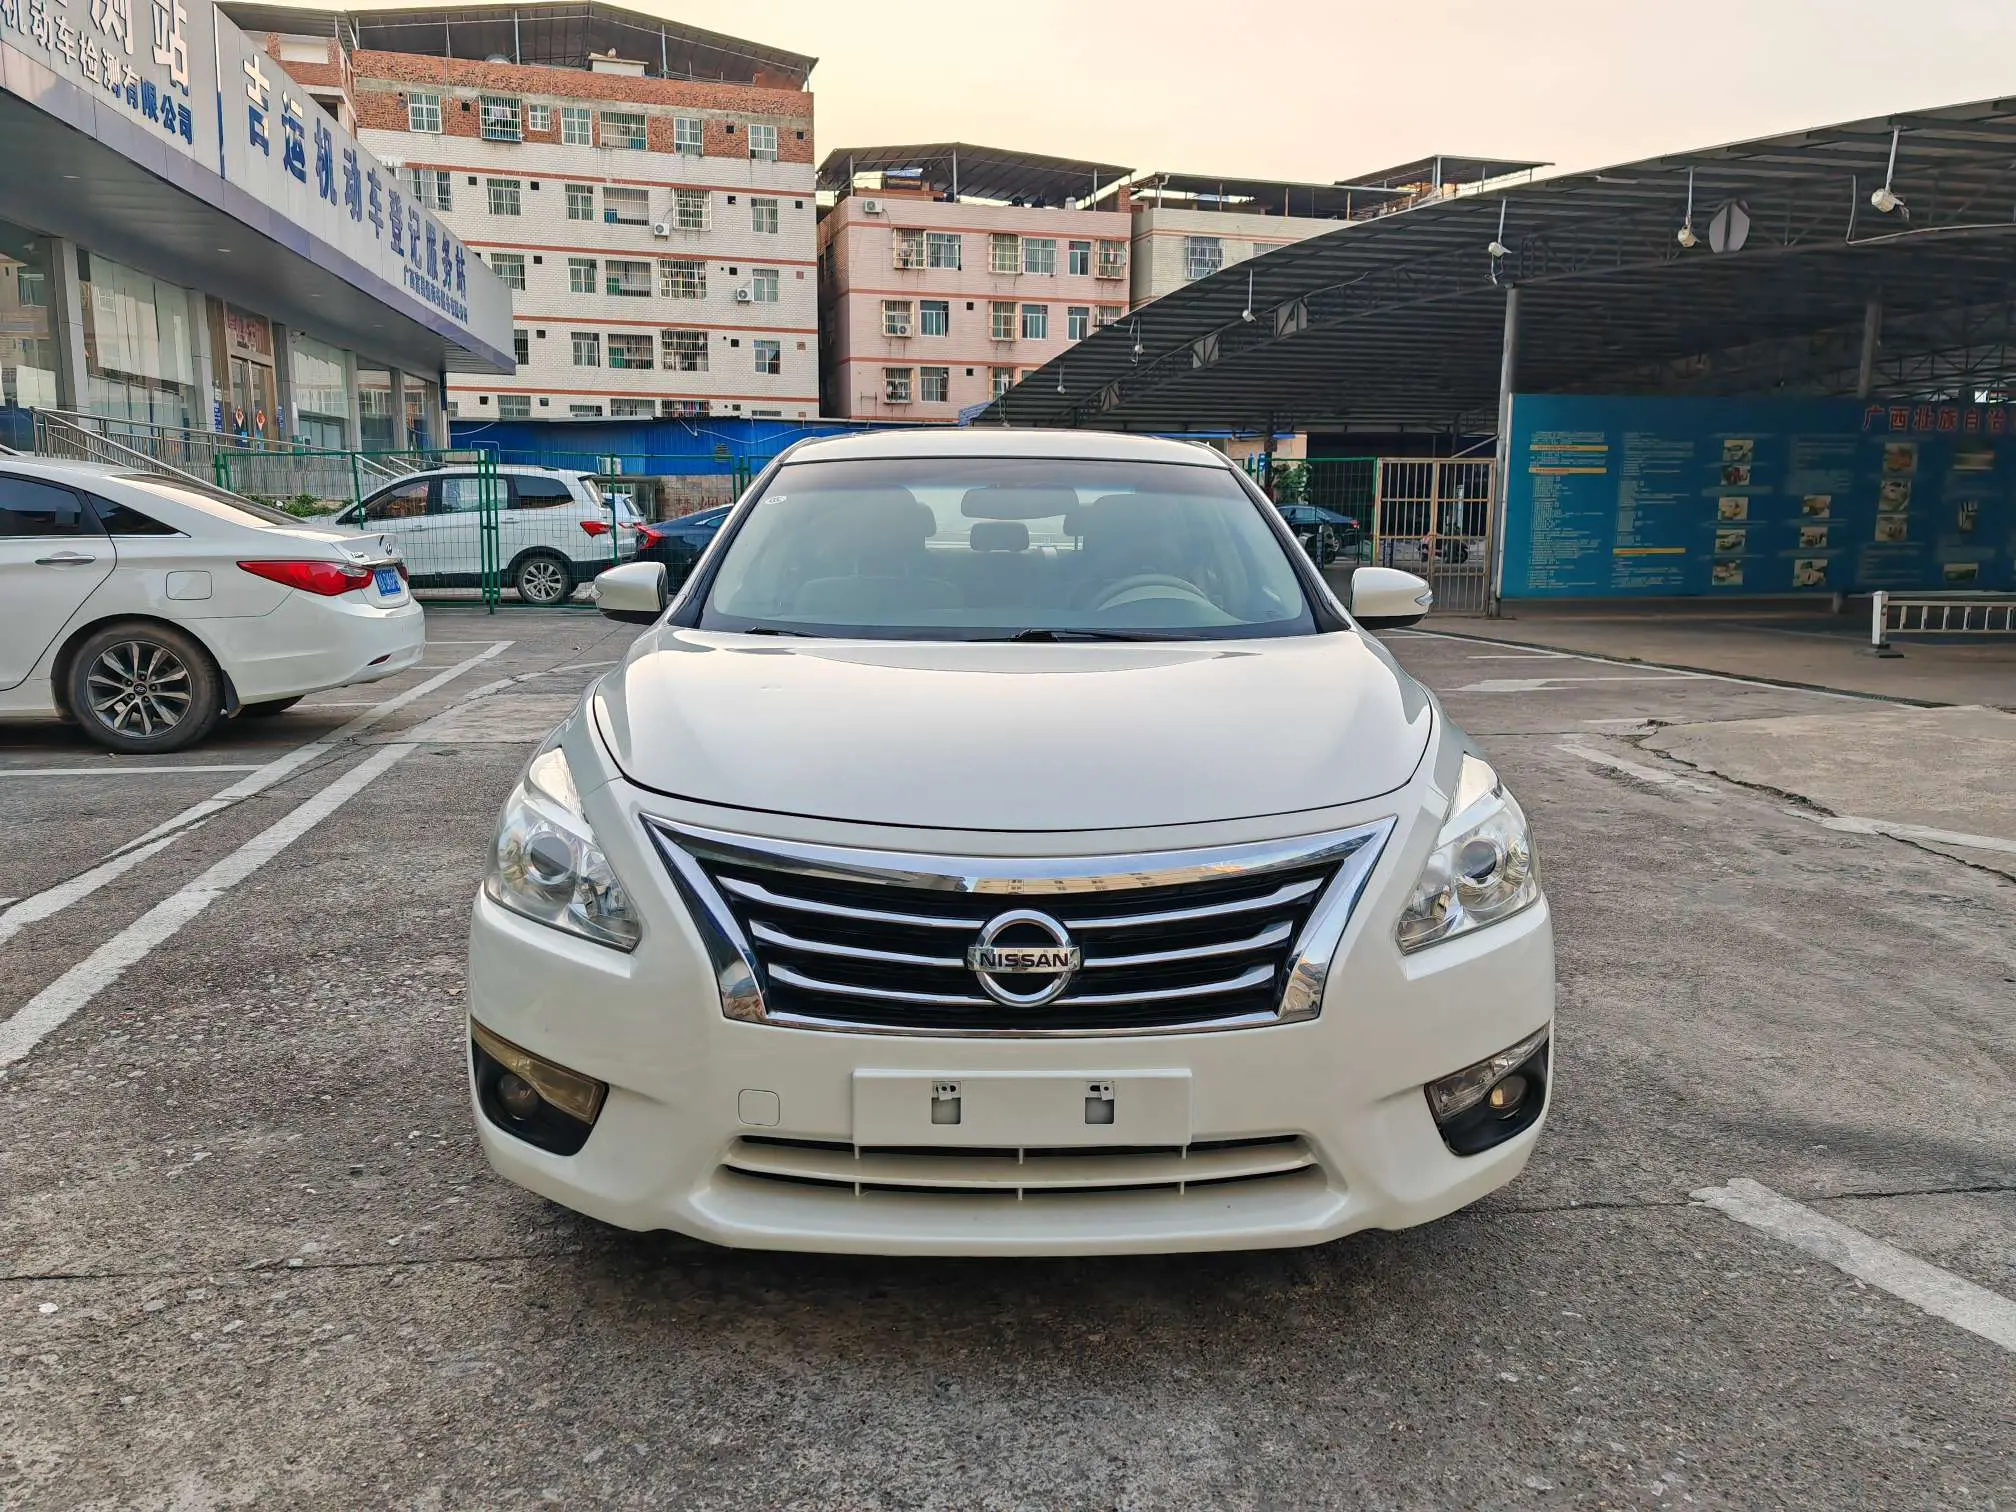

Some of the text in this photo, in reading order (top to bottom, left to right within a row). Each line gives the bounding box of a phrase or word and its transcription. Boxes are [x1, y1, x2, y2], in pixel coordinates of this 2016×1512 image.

[242, 54, 467, 301] 吉运机动车登记服务站
[980, 953, 1069, 968] NISSAN
